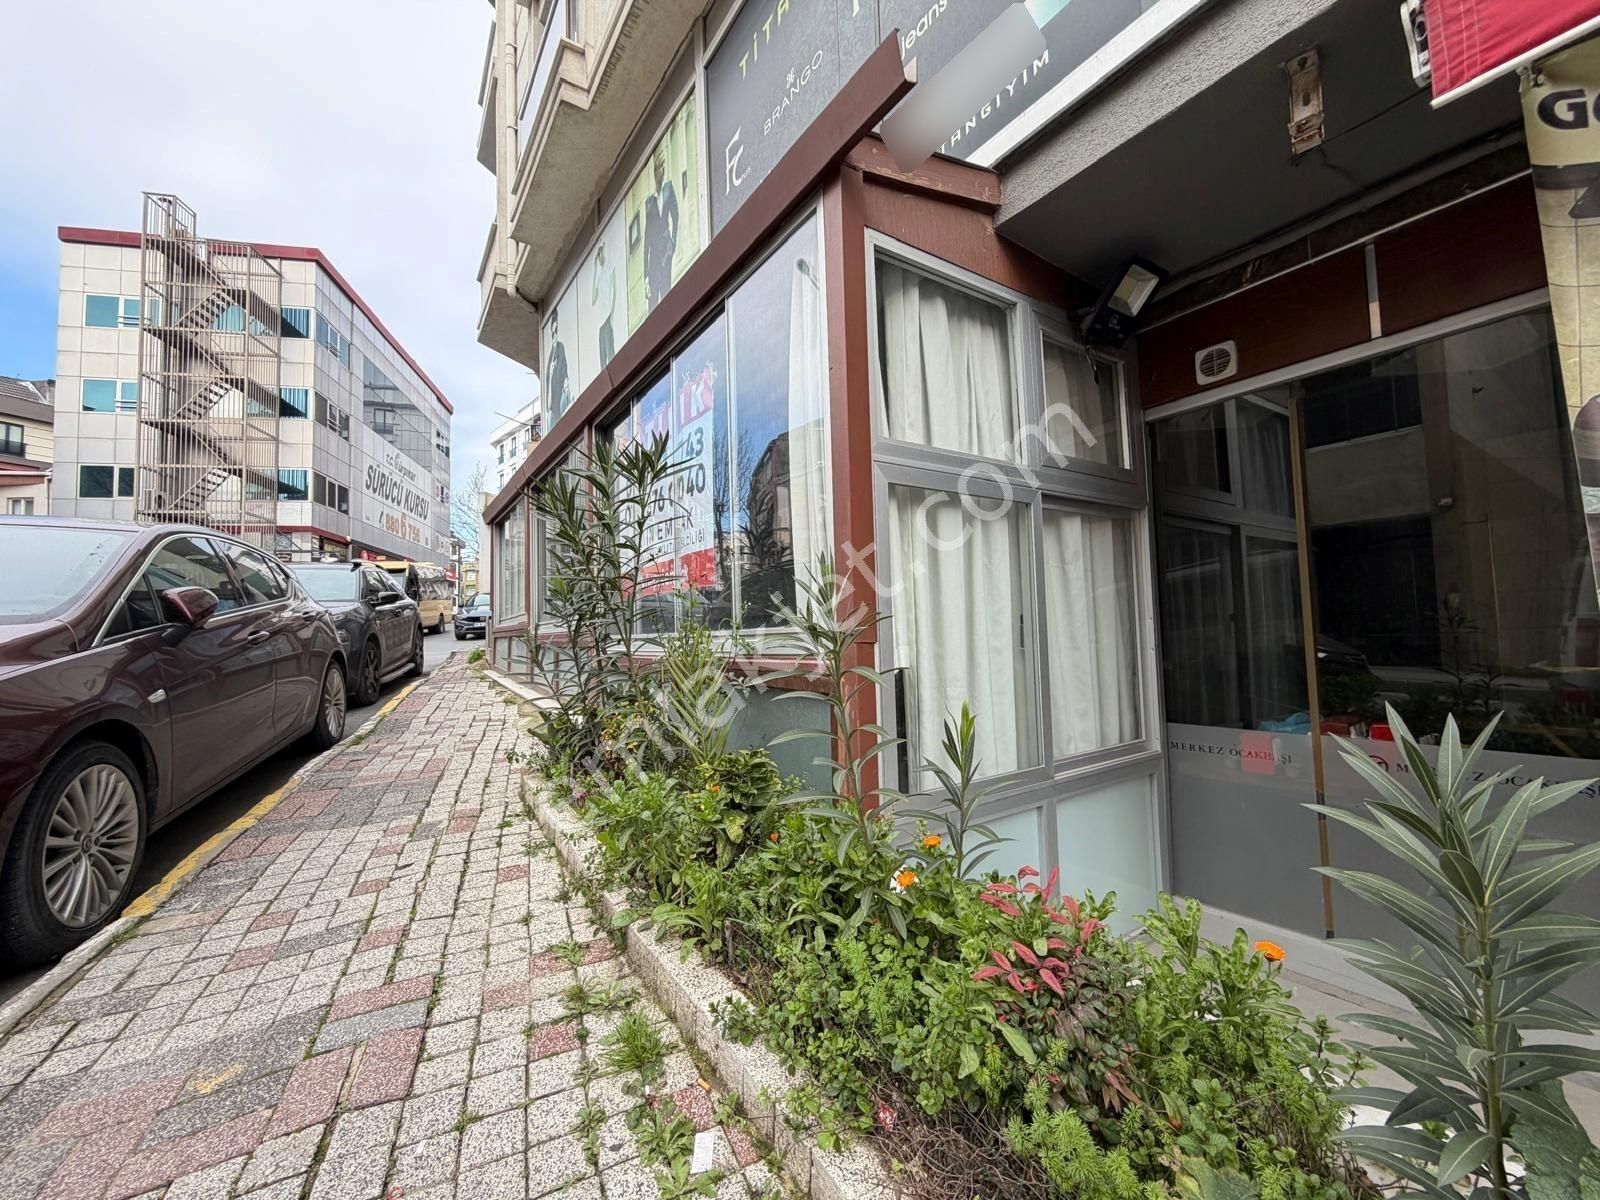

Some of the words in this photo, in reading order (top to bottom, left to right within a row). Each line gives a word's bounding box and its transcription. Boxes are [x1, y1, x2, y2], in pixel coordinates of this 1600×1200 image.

[900, 0, 948, 60] jeans
[763, 50, 823, 137] BRANGO
[1537, 89, 1600, 130] G
[365, 463, 404, 507] SÜRÜCÜ
[403, 487, 430, 521] KURSU
[1170, 741, 1225, 756] MERKEZ
[1229, 746, 1292, 765] OCAKBŞI
